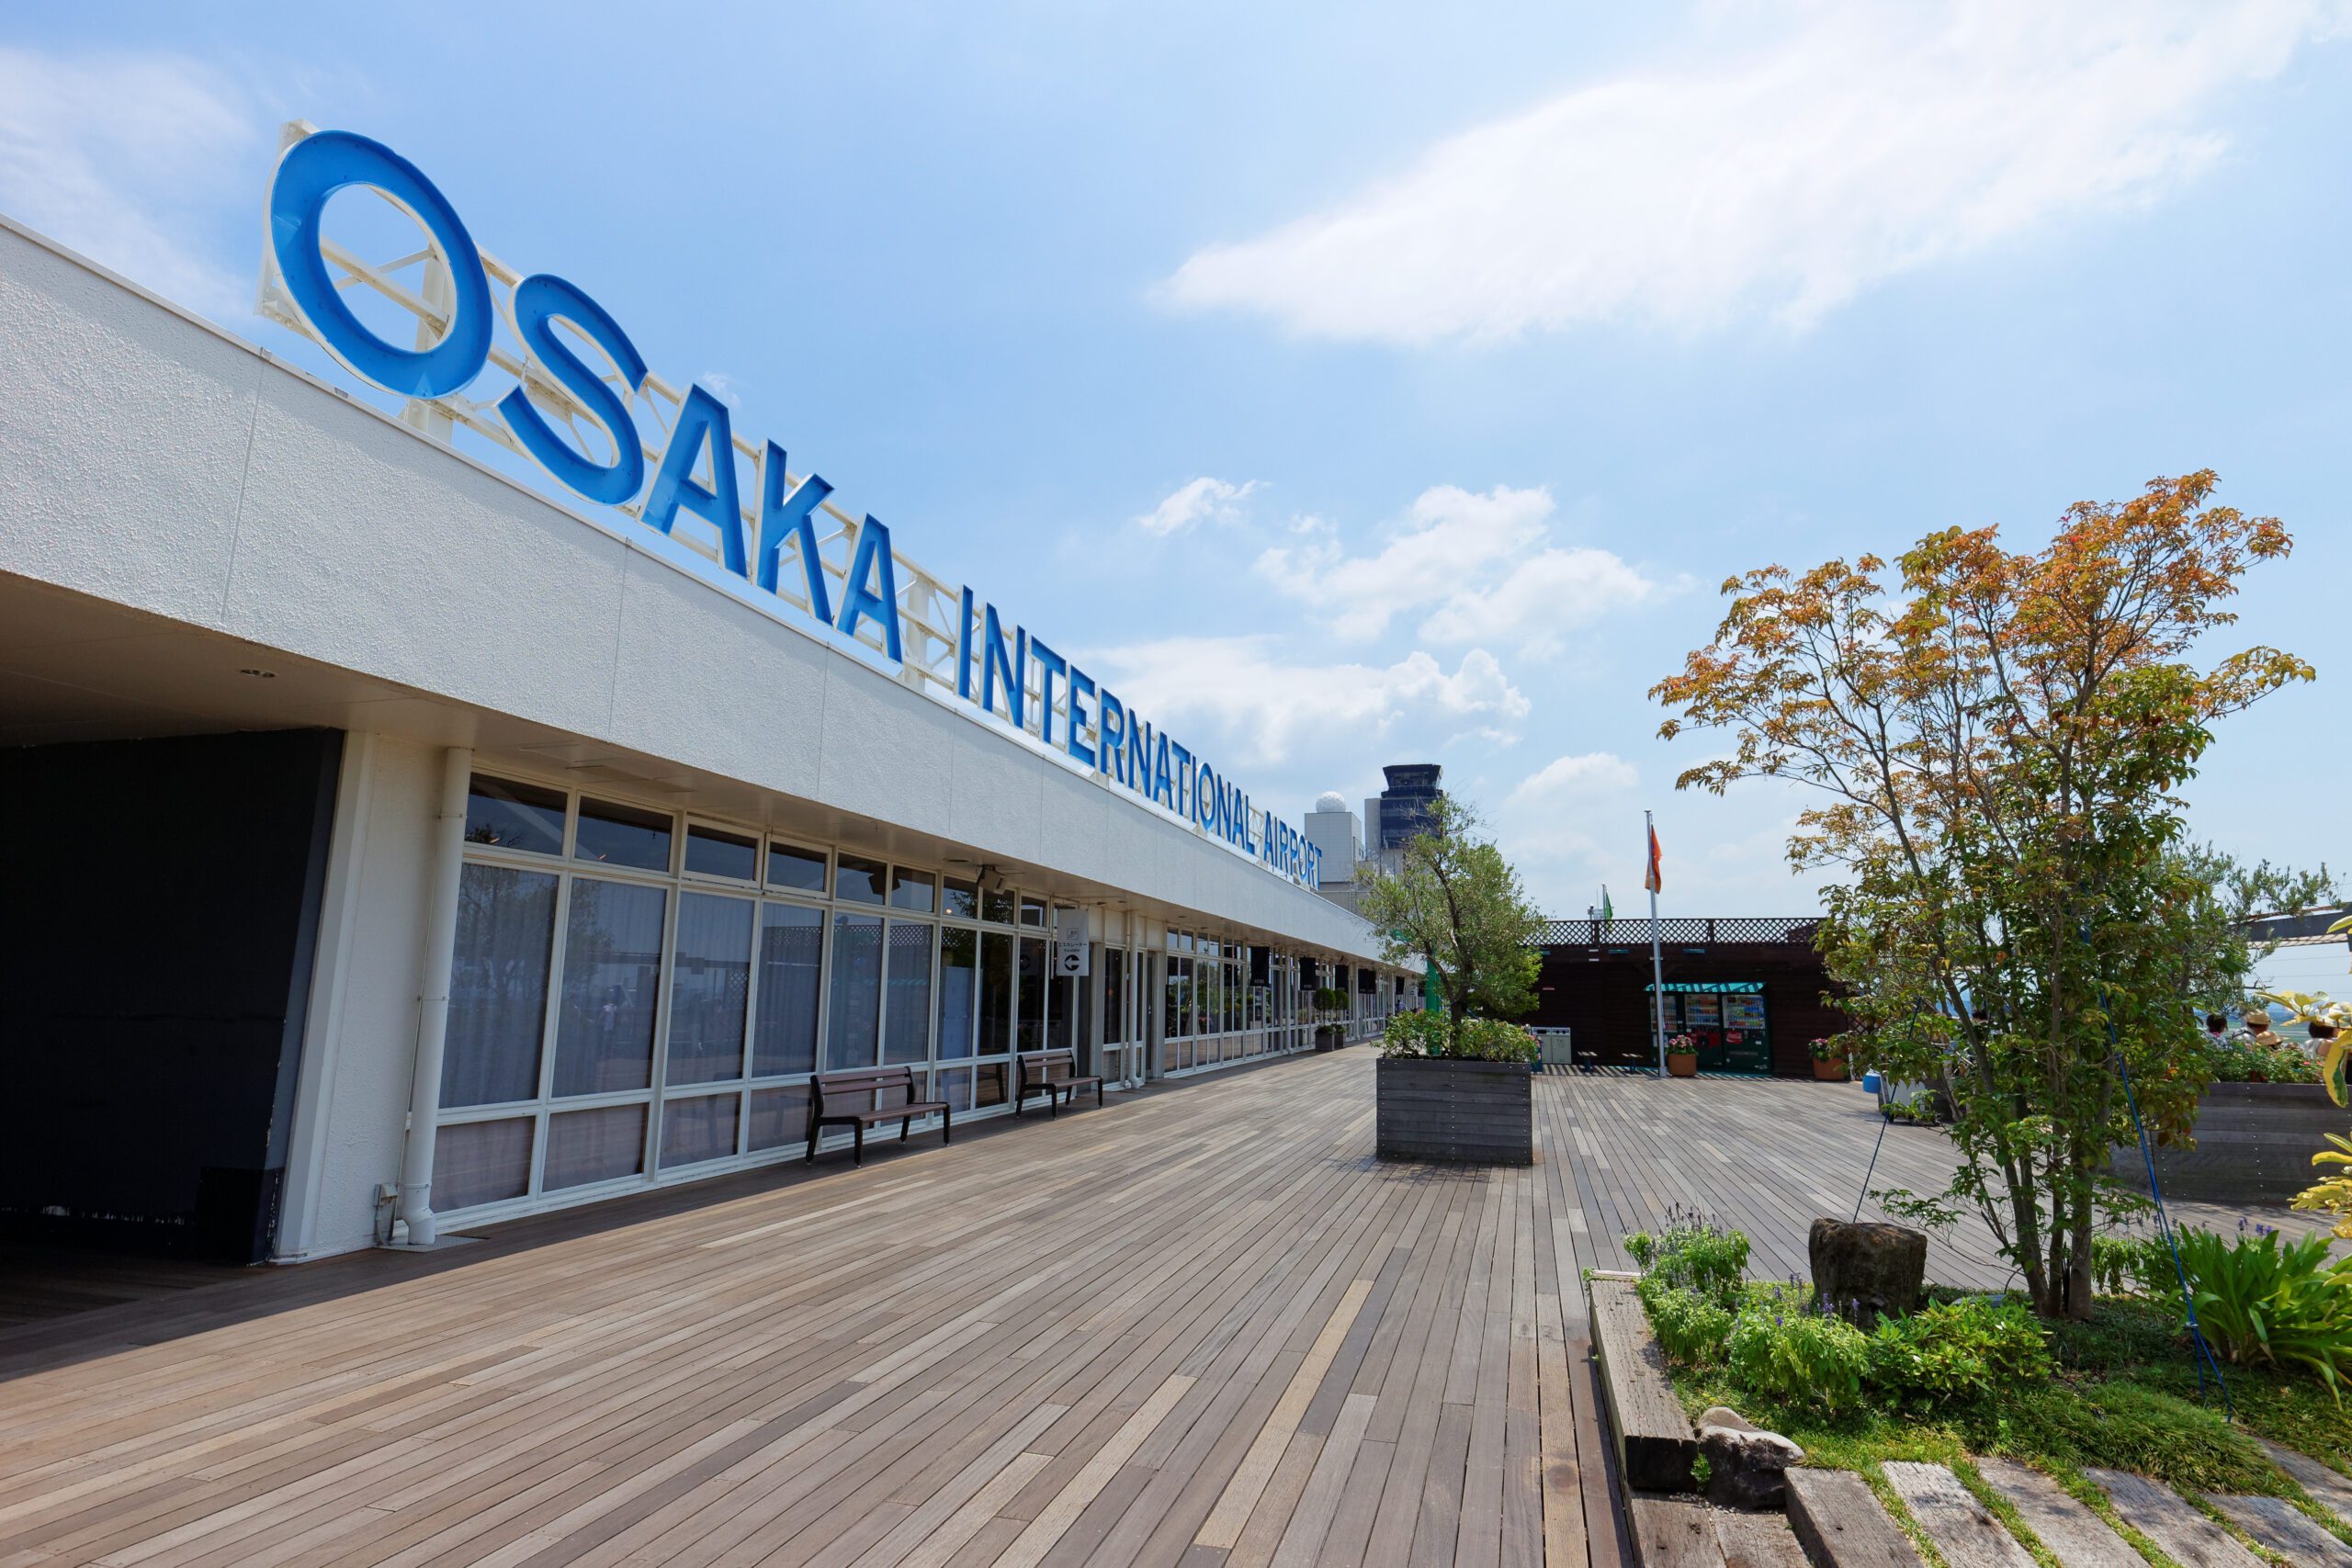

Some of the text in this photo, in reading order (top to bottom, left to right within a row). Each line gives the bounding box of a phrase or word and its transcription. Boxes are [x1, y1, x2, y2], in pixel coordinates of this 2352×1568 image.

[265, 130, 1322, 891] OSAKA INTERNATIONAL AIRPORT
